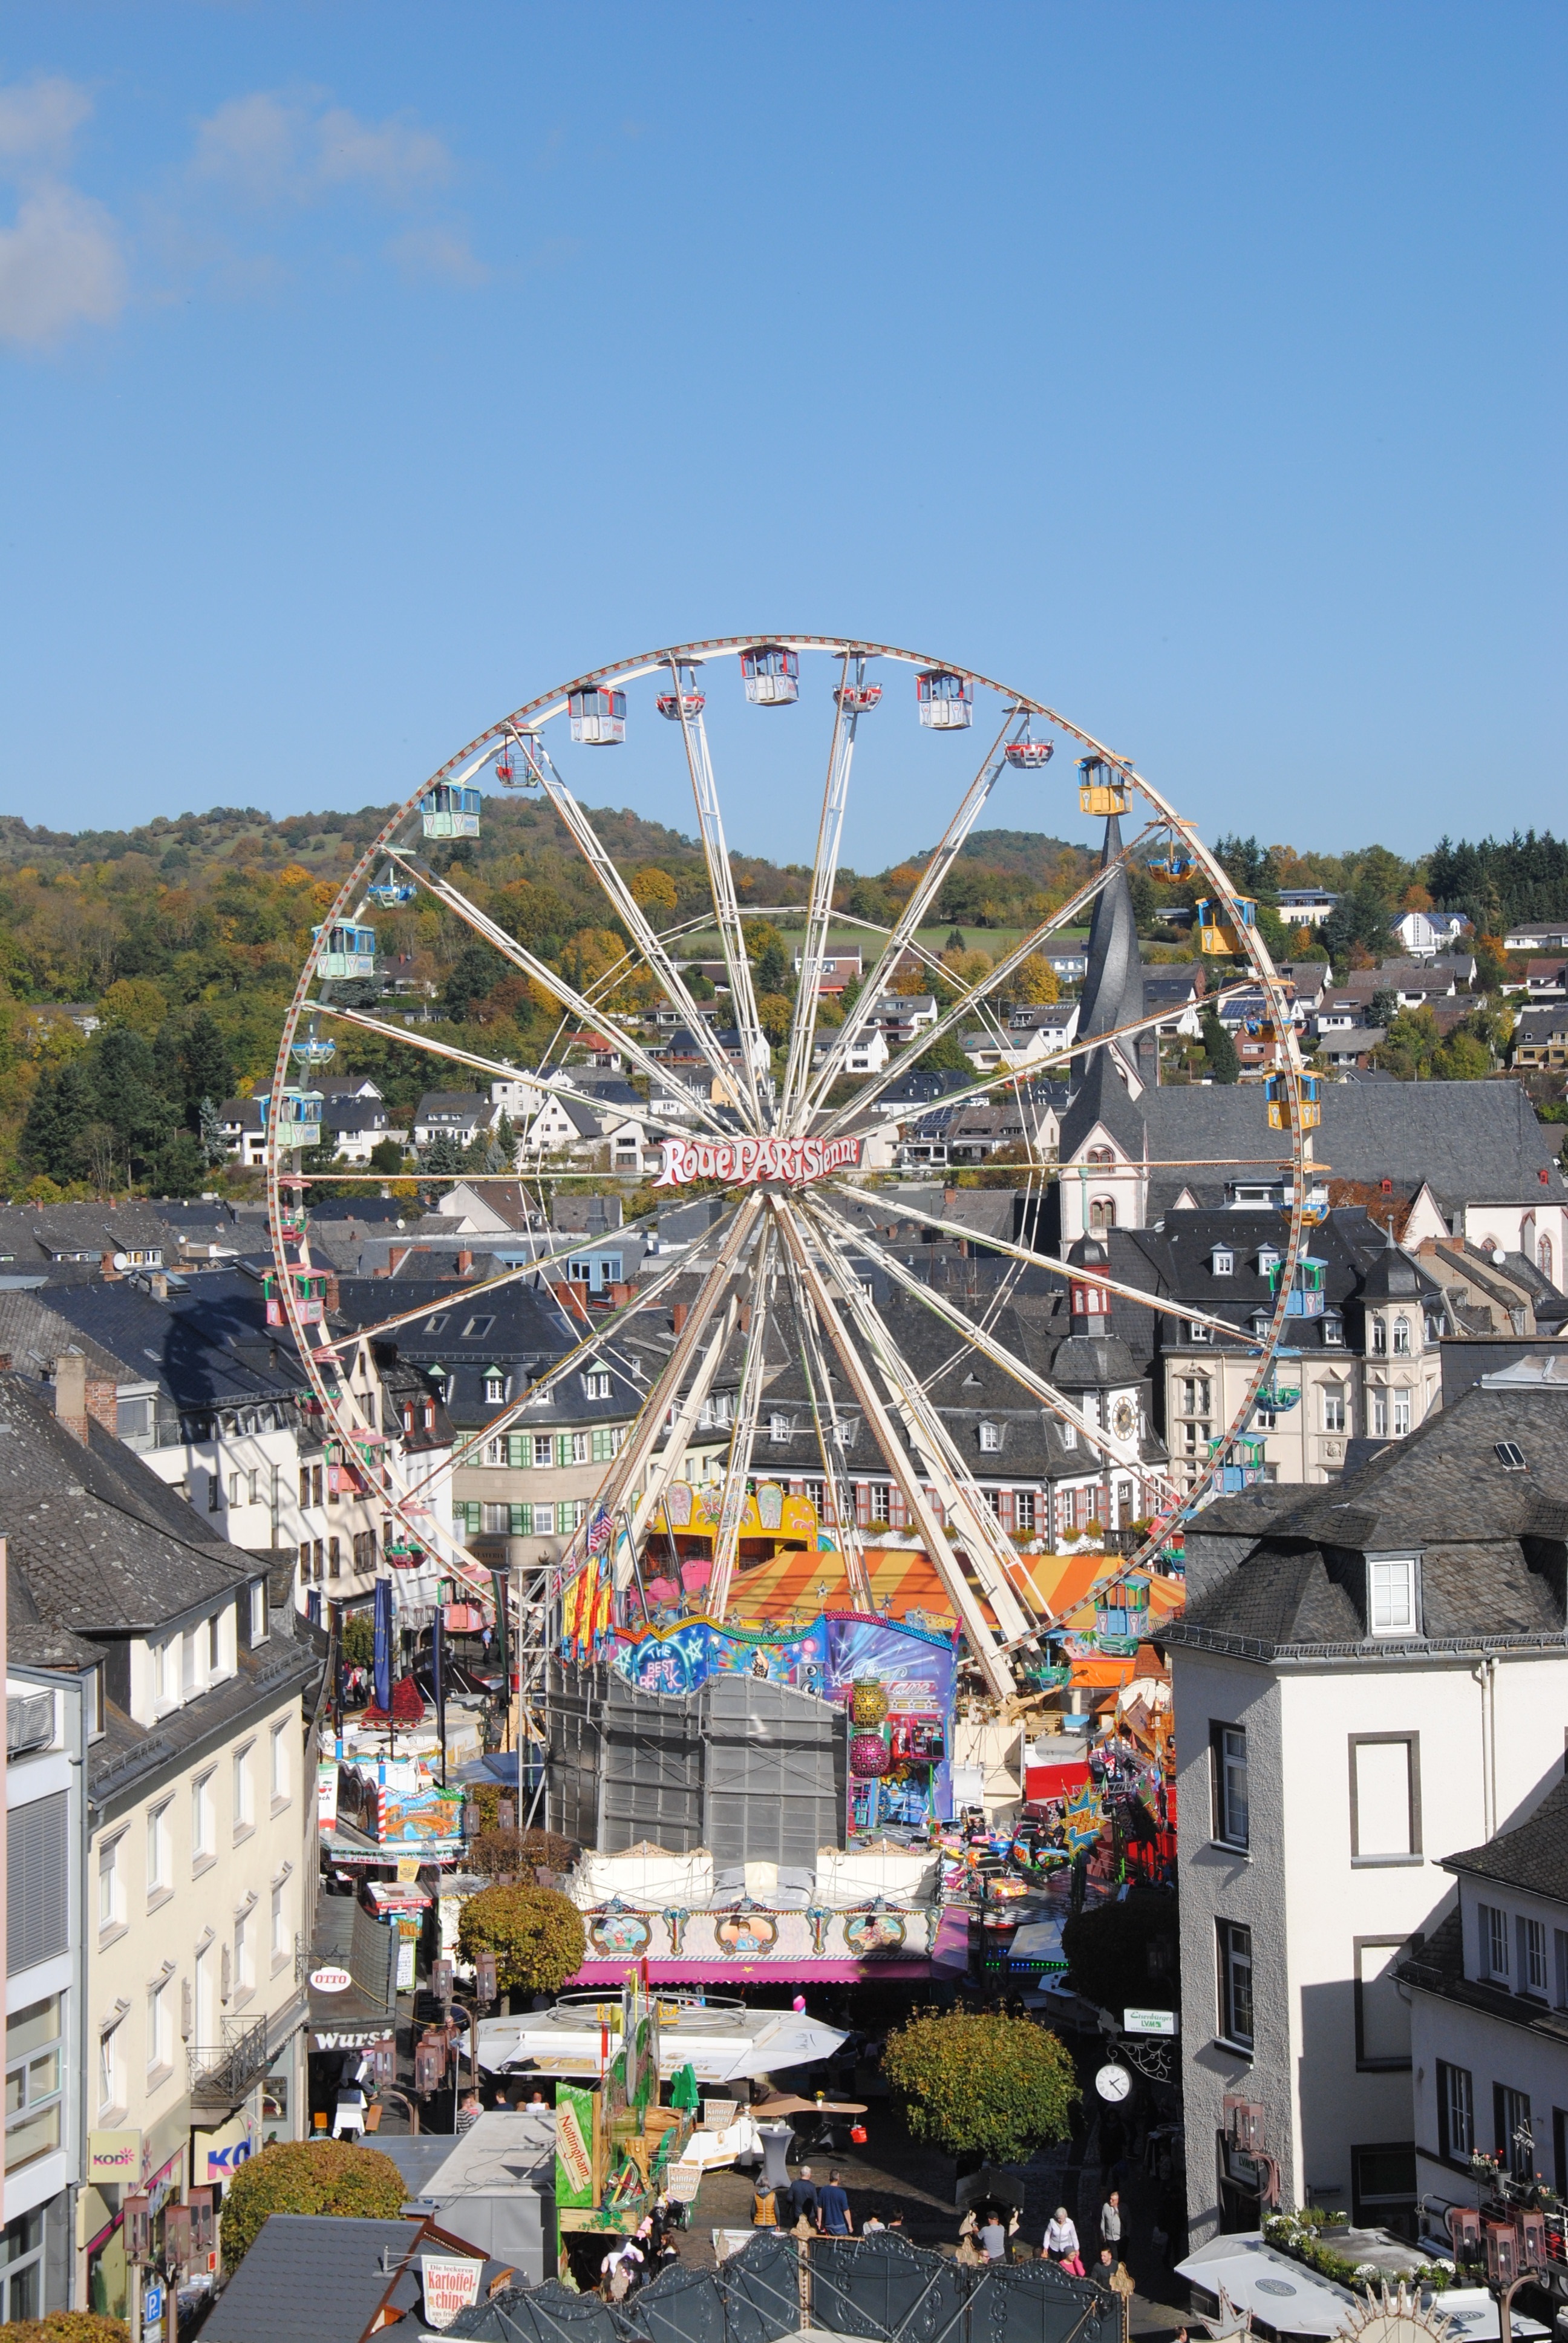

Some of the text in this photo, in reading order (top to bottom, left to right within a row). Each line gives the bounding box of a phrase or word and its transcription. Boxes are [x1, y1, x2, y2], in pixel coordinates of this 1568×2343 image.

[647, 1644, 671, 1659] THE
[647, 1659, 677, 1674] BEST
[315, 1974, 347, 1984] OTTO
[315, 2028, 393, 2050] Wurst
[558, 2114, 590, 2177] Nottingham
[428, 2271, 477, 2292] Kartoffel-
[149, 2294, 157, 2319] P
[436, 2291, 464, 2312] chips
